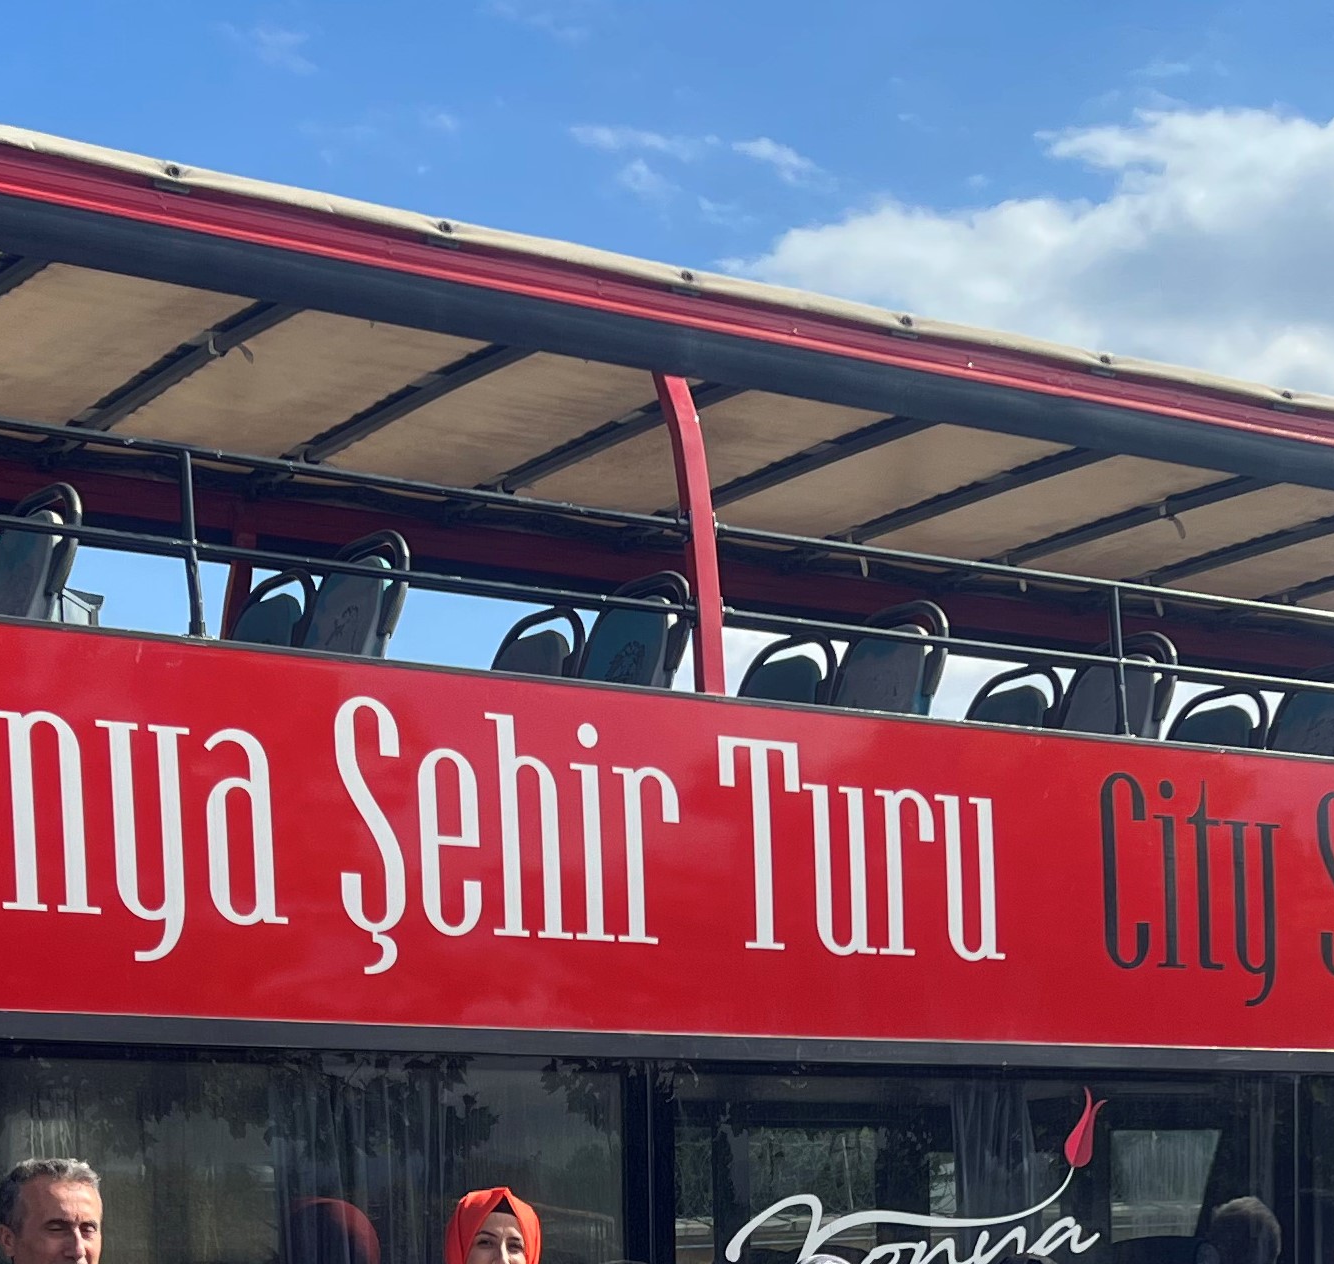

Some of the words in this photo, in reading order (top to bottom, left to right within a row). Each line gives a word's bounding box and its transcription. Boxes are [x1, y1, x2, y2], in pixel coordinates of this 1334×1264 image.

[334, 696, 680, 974] Şehir
[716, 734, 1005, 961] Turu
[1100, 772, 1281, 1007] City
